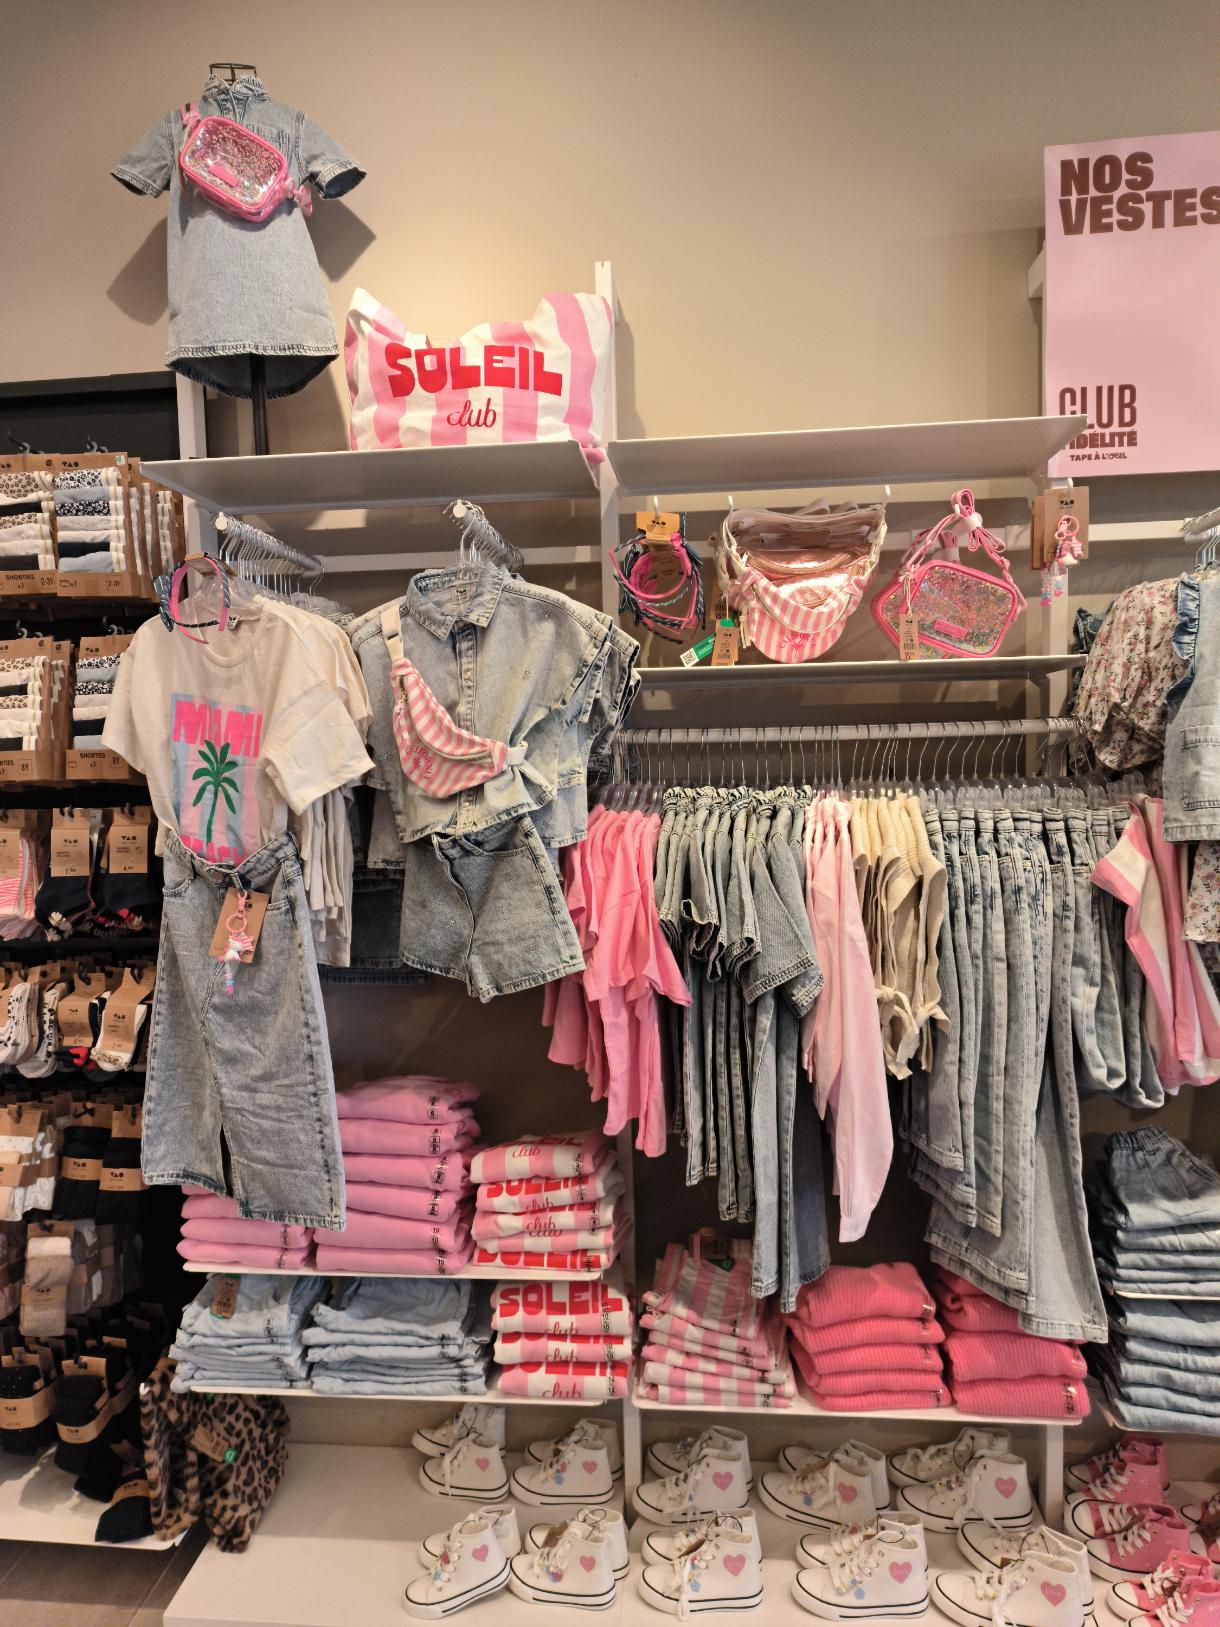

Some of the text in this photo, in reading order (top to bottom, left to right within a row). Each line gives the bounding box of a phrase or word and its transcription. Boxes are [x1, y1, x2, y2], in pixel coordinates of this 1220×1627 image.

[1060, 151, 1154, 197] NOS
[1059, 185, 1220, 236] VESTES
[384, 342, 562, 397] SOLEIL
[446, 397, 497, 428] club
[1062, 429, 1138, 450] IDÉLITÉ
[1069, 454, 1093, 462] TAPE
[499, 1280, 623, 1318] SOLEIL
